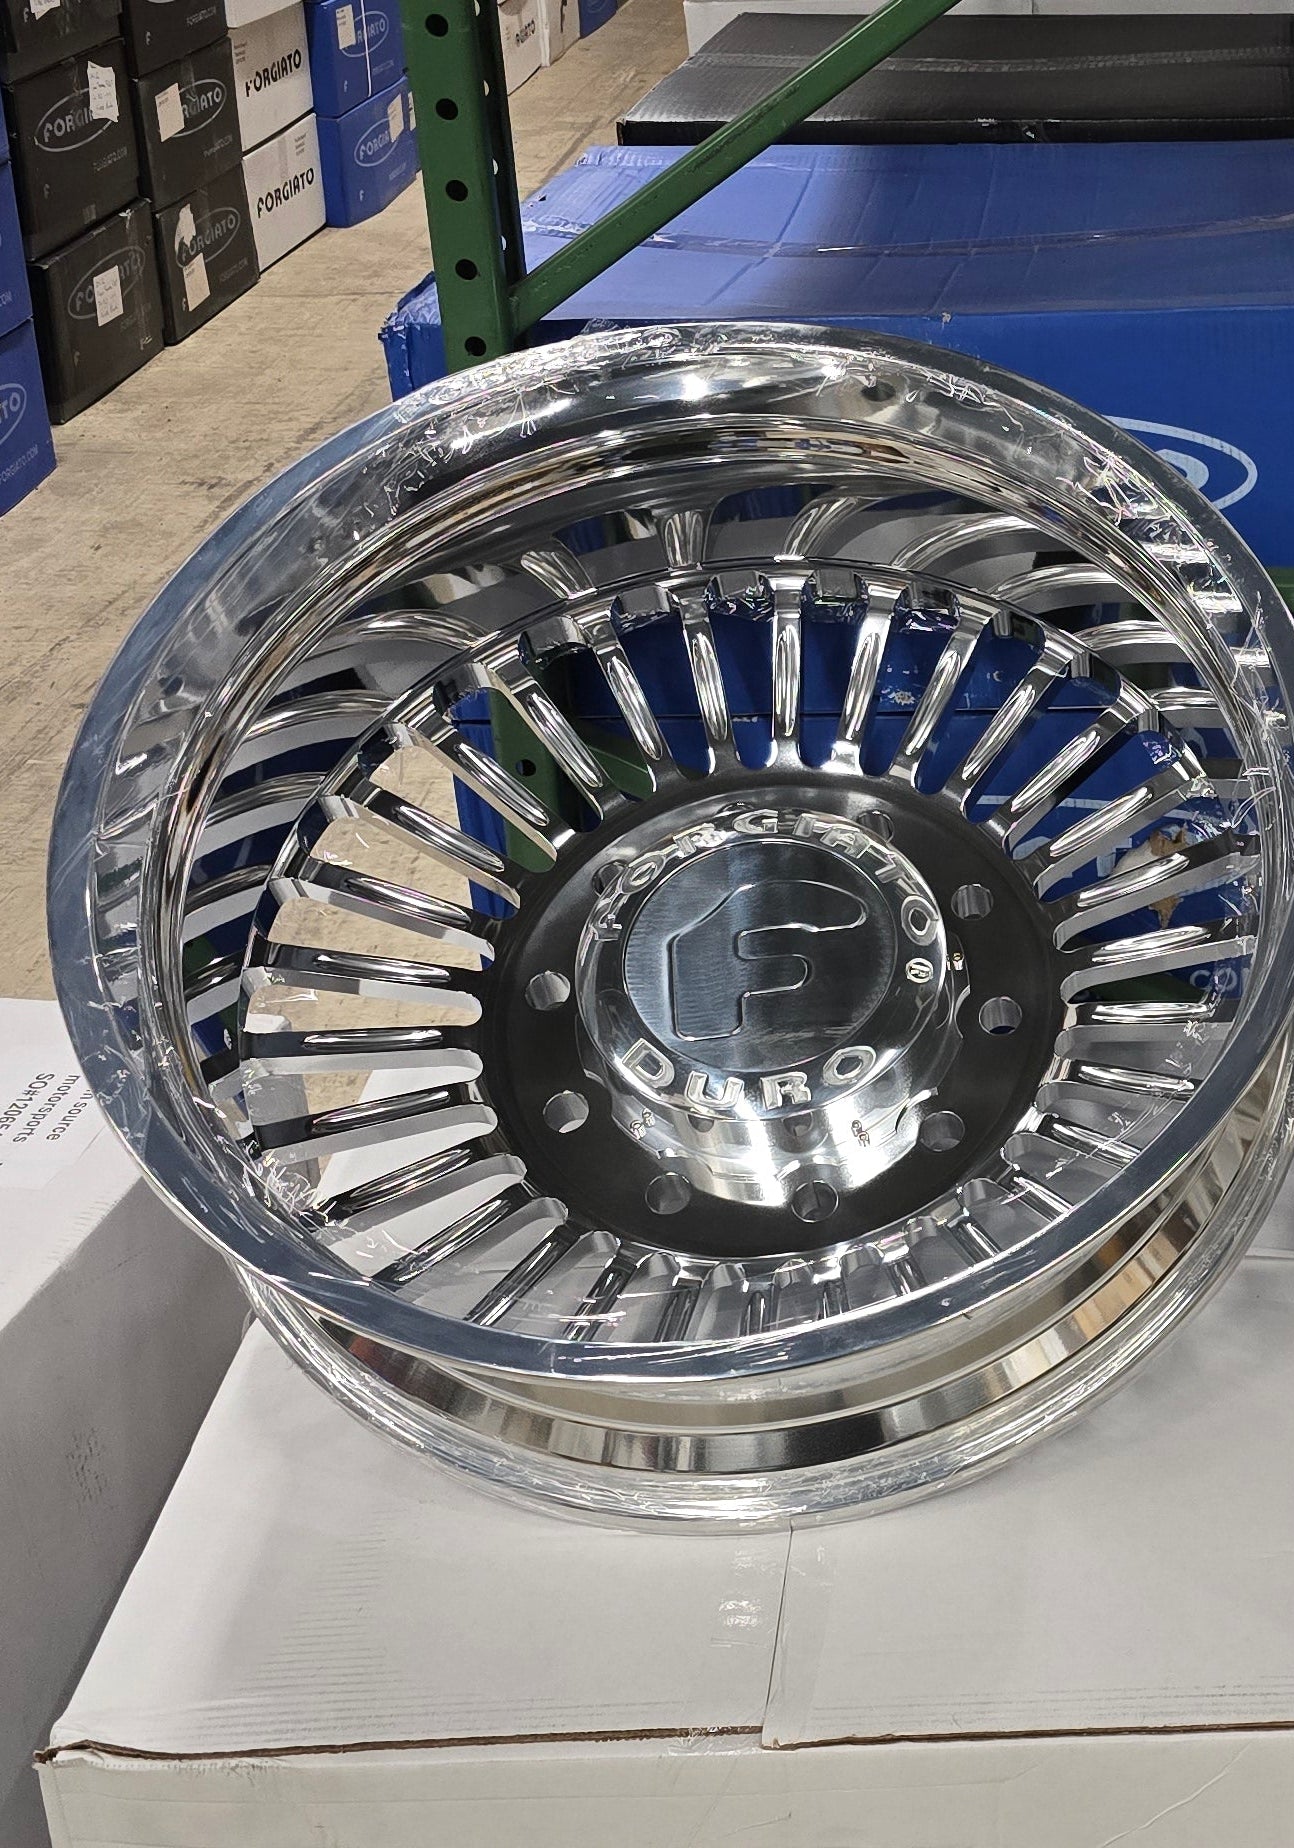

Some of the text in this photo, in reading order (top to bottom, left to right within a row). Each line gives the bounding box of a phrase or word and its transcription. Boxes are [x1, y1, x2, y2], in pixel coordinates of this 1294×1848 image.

[245, 48, 302, 97] FORGIATO
[43, 107, 93, 143] FORGI
[257, 168, 315, 218] FORGIATO
[622, 1037, 877, 1110] DURO
[13, 1074, 80, 1143] motorsports
[46, 1101, 87, 1141] source
